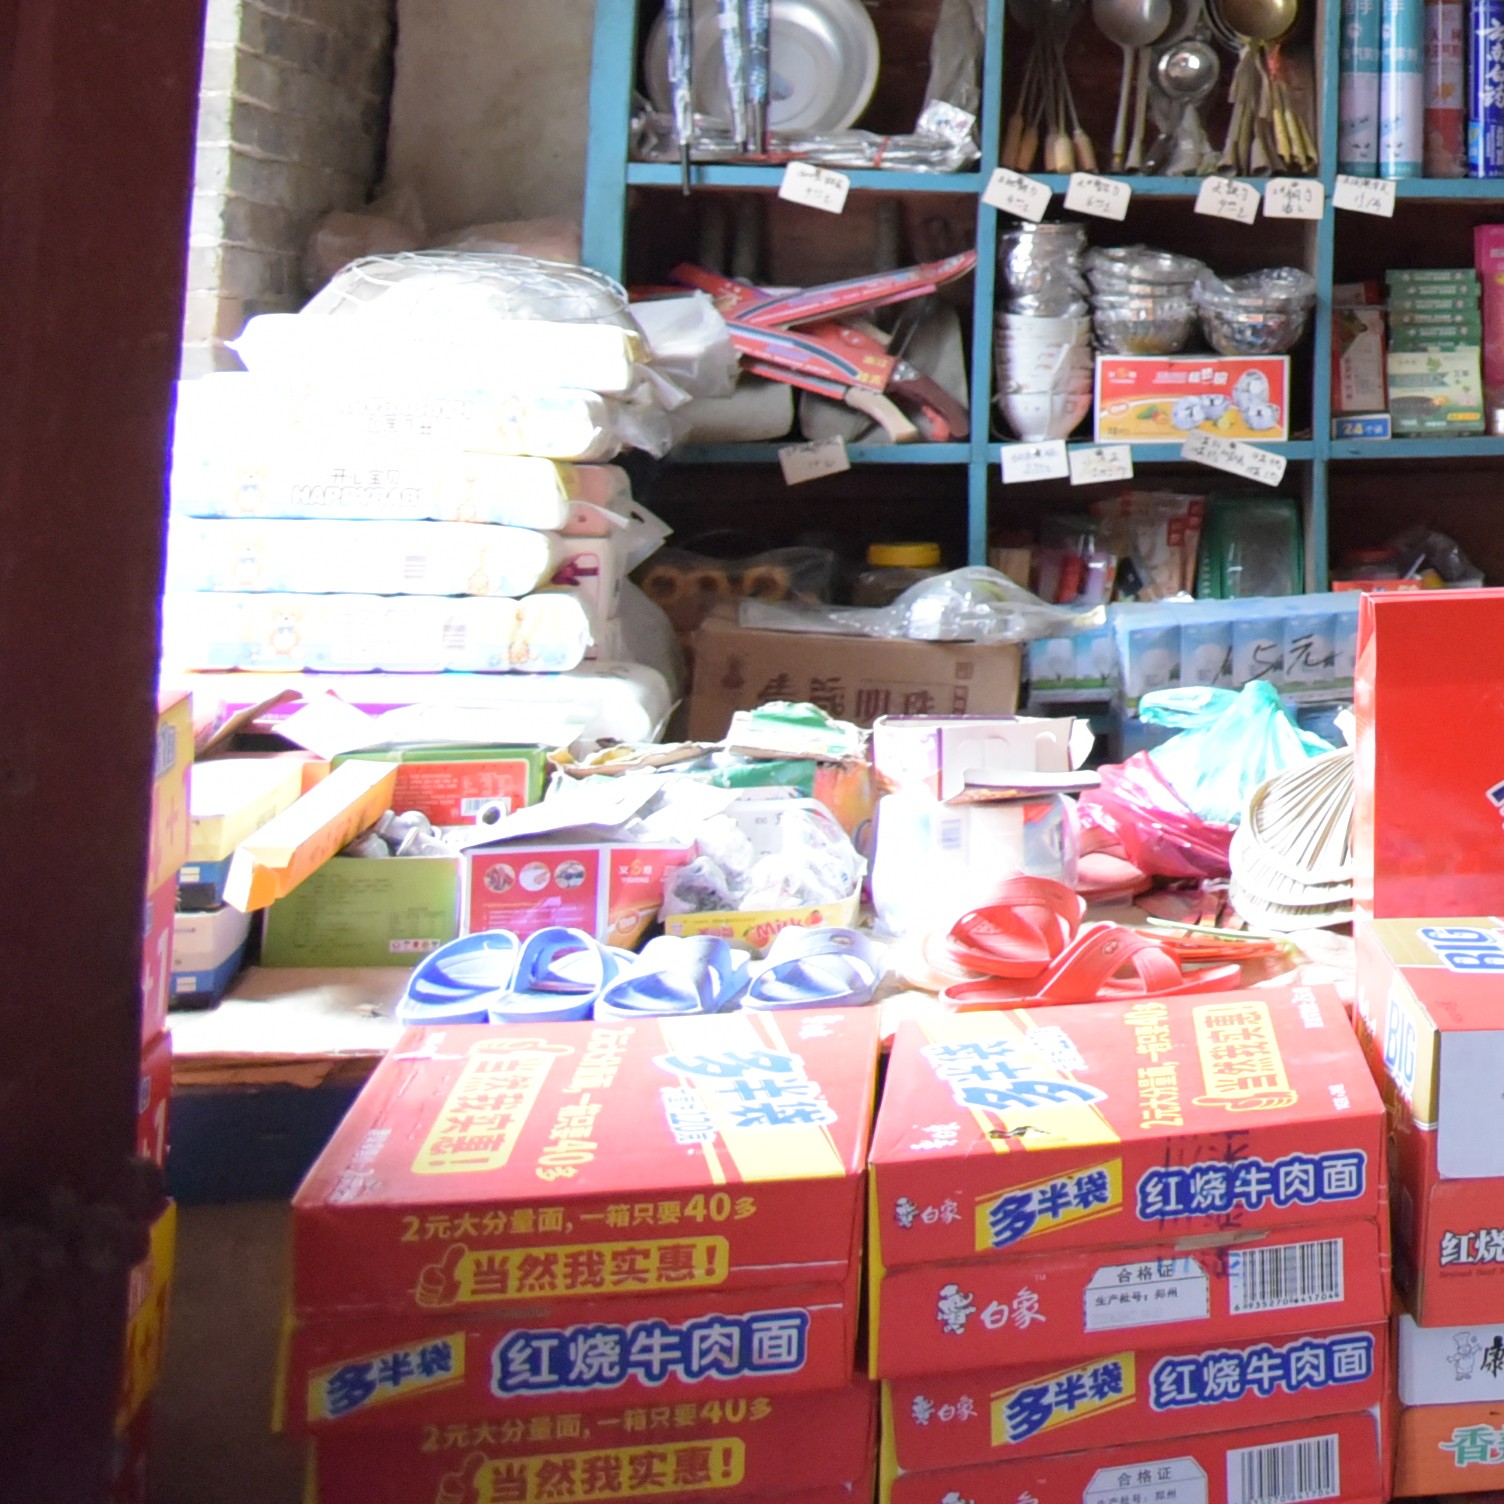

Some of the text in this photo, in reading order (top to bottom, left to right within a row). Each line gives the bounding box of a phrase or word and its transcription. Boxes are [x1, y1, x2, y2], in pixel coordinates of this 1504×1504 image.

[988, 1168, 1112, 1248] 多半袋
[1140, 1152, 1364, 1220] 红烧牛肉面
[468, 1239, 720, 1298] 当然我实惠!
[1116, 1262, 1176, 1286] 合格证
[979, 1283, 1048, 1330] 白象
[324, 1342, 454, 1416] 多半袋
[500, 1314, 803, 1389] 红烧牛肉面
[1152, 1337, 1372, 1406] 红烧牛肉面
[1004, 1361, 1125, 1443] 多半袋
[489, 1441, 738, 1502] 当然我实惠!
[1116, 1465, 1174, 1488] 合格证
